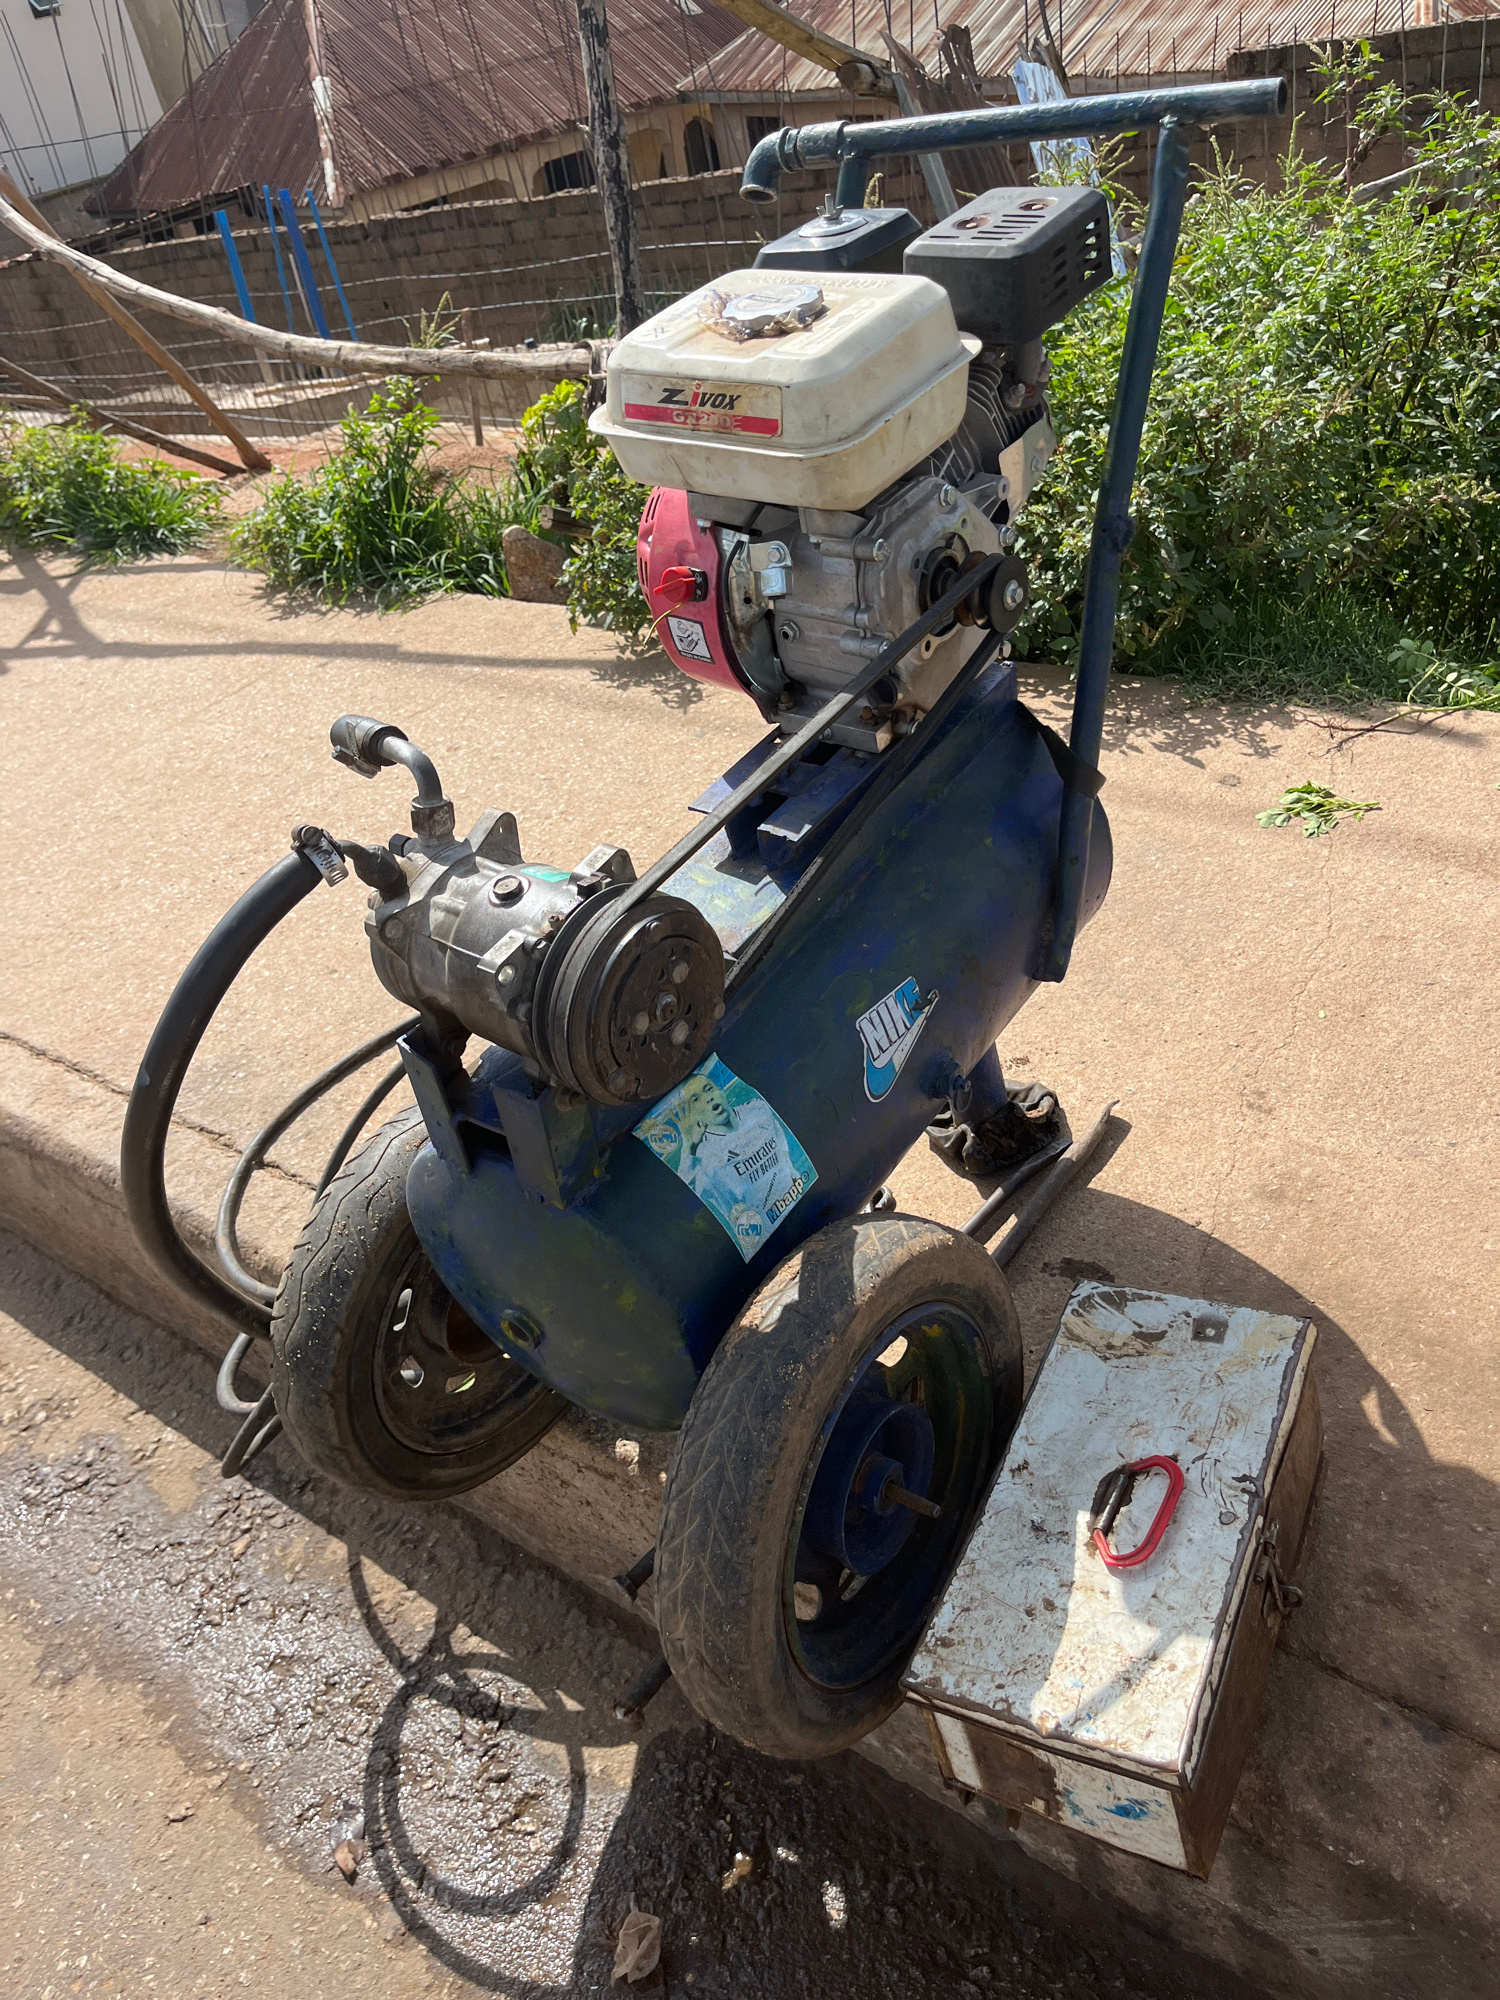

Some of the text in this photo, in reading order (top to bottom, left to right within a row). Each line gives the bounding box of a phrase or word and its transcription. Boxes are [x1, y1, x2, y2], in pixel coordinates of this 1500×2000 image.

[733, 1136, 778, 1177] Emirates
[748, 1151, 780, 1185] FLY BETTER
